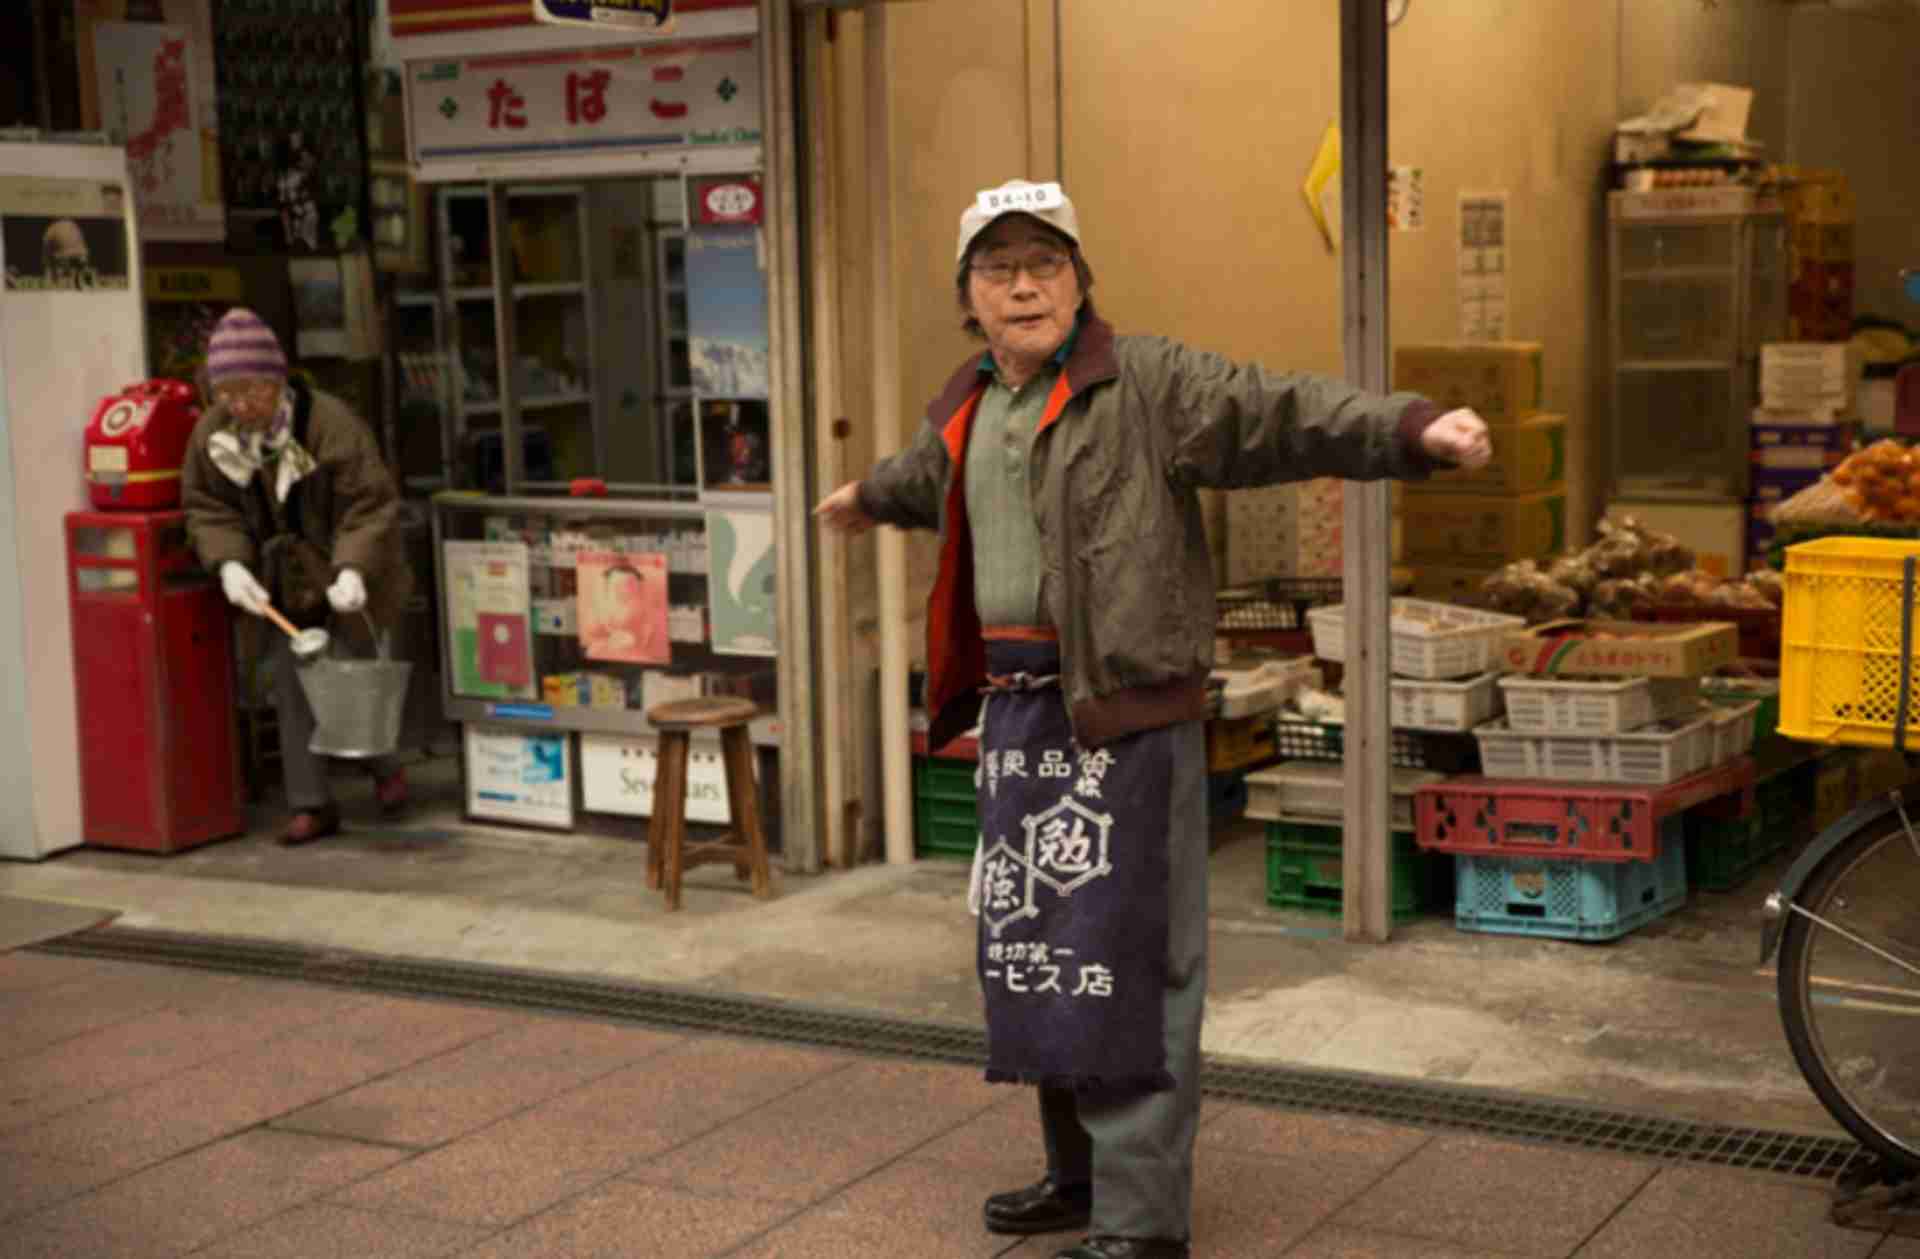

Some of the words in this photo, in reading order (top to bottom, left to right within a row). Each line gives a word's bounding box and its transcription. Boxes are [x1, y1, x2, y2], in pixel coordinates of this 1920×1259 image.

[486, 66, 688, 128] たばこ
[984, 963, 1116, 998] ービス店
